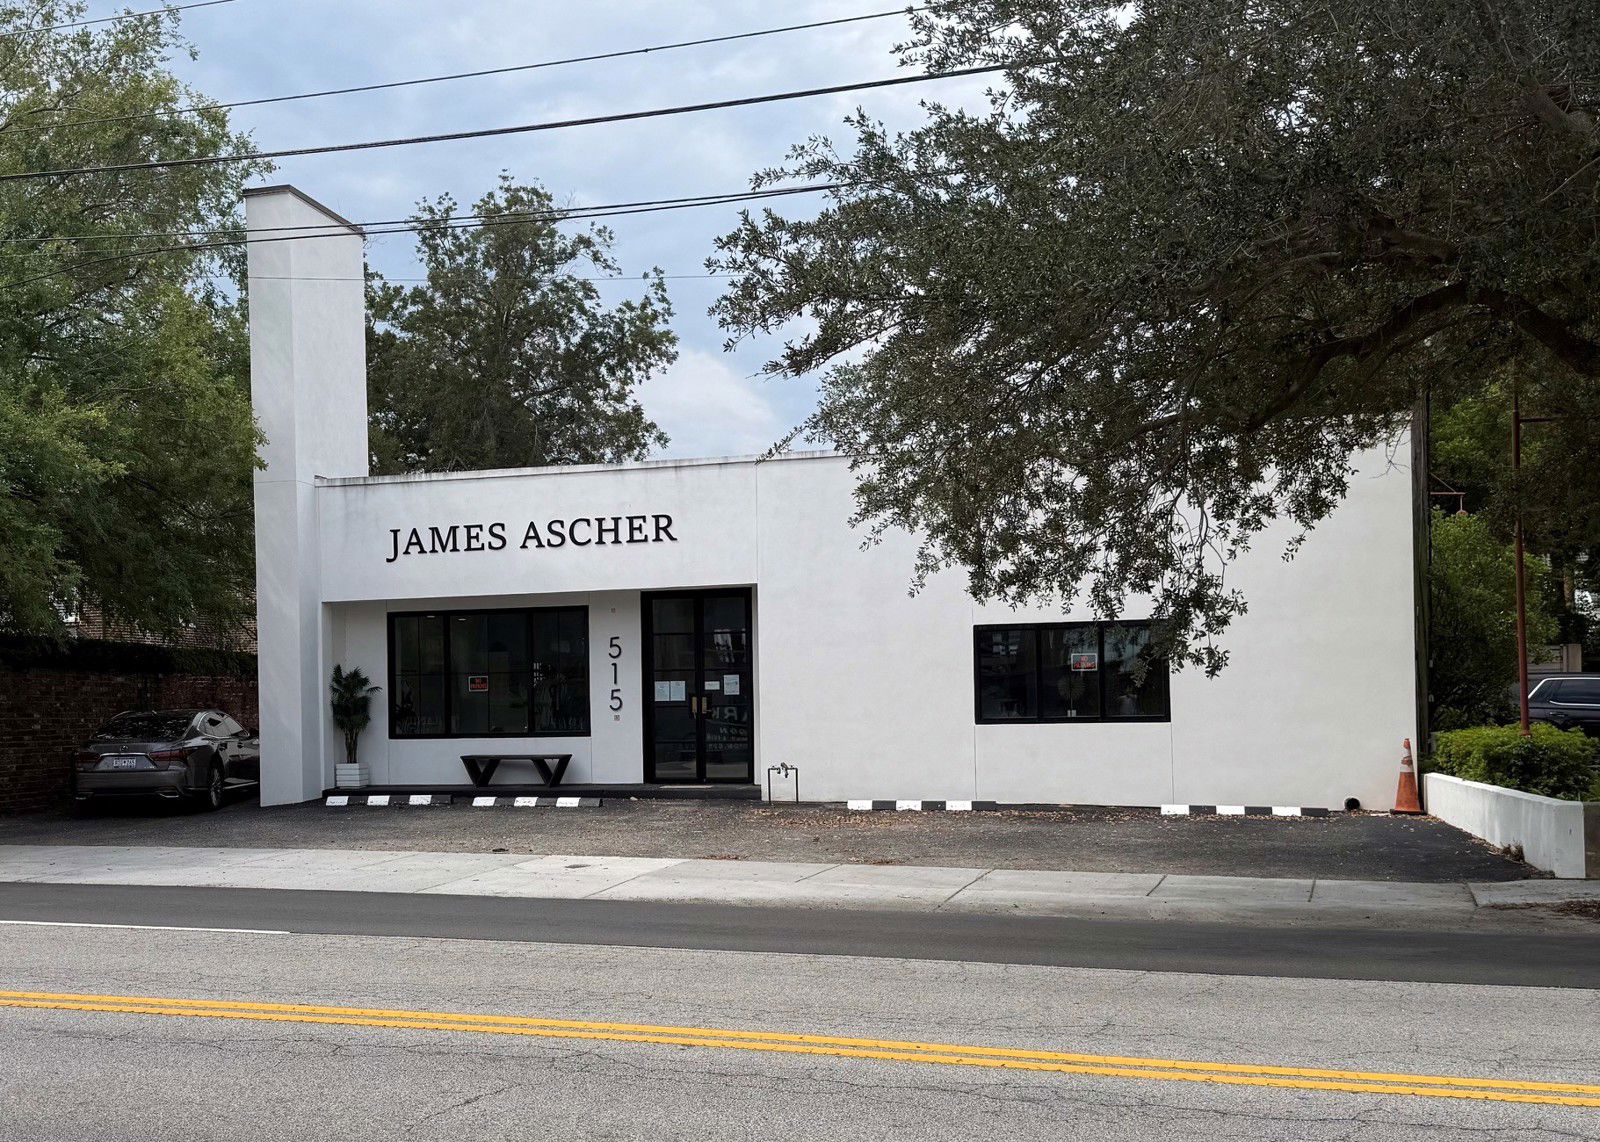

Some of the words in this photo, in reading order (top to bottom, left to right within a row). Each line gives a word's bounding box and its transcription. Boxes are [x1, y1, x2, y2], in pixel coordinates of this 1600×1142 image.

[385, 522, 507, 563] JAMES
[519, 513, 678, 549] ASCHER
[608, 636, 623, 712] 515
